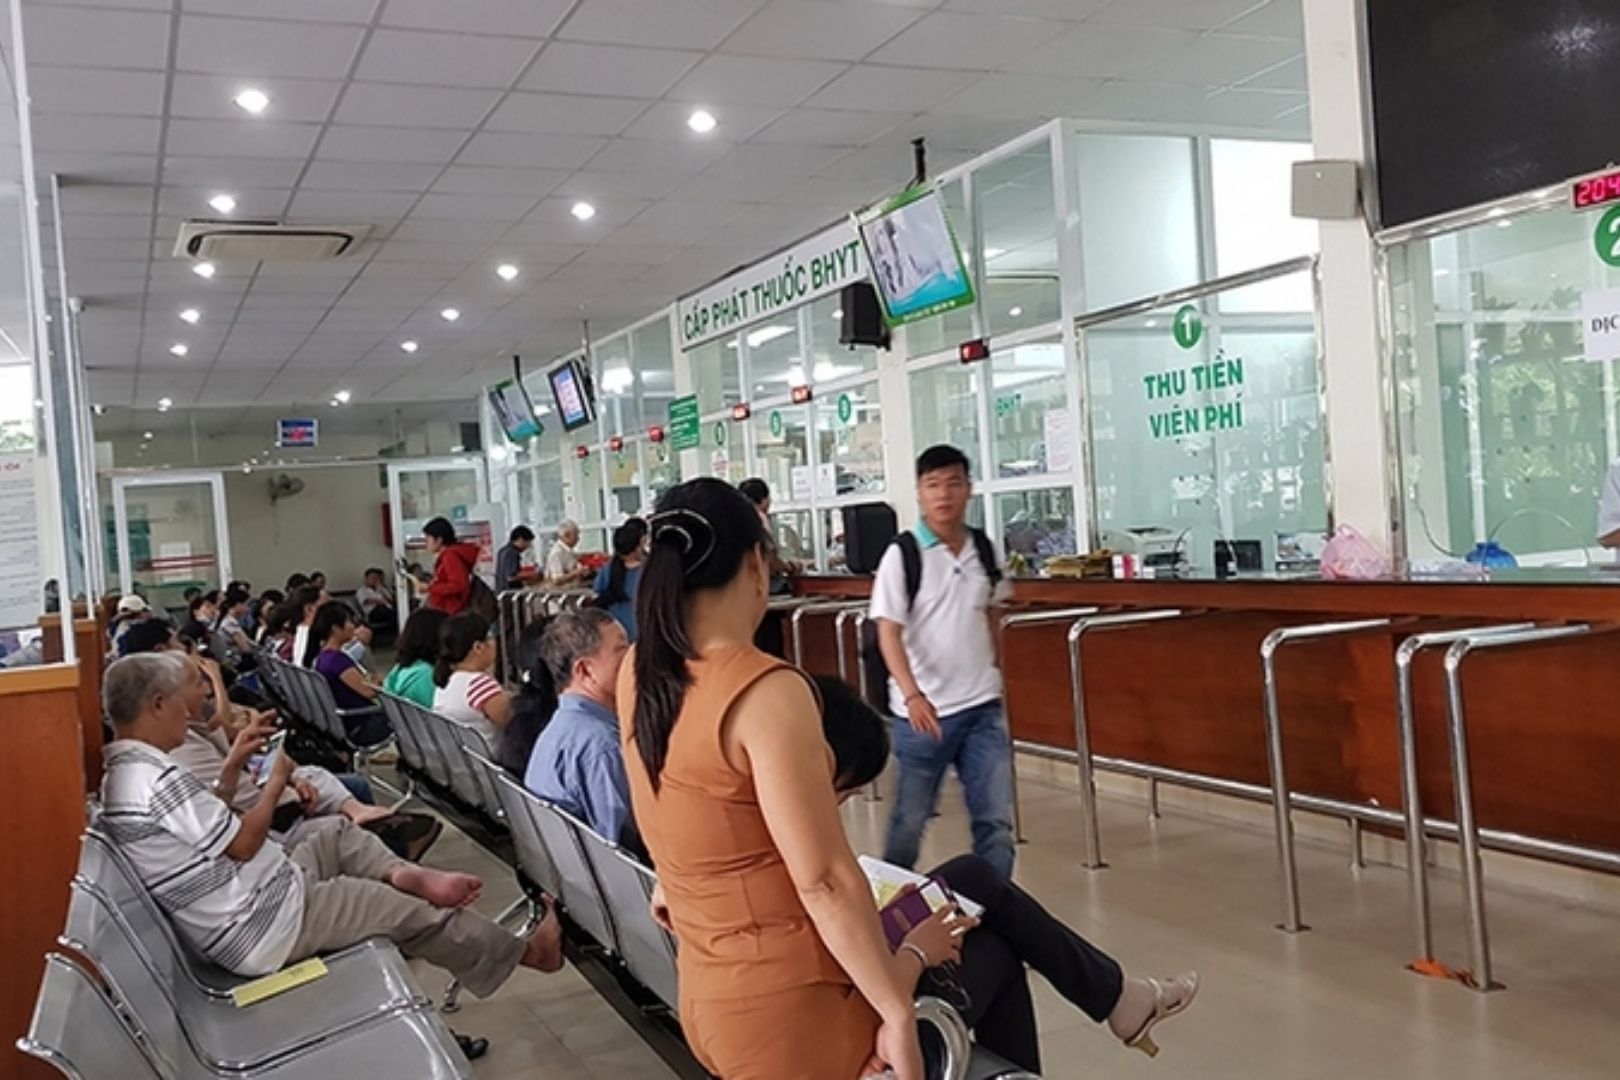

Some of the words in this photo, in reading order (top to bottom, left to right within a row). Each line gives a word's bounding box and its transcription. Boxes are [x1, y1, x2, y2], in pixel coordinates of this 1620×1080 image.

[712, 288, 748, 330] PHÁT
[752, 256, 807, 313] THUỐC
[811, 240, 859, 289] BHYT
[1181, 314, 1192, 341] 1
[1143, 370, 1187, 399] THU
[1191, 348, 1243, 392] TIỀN
[1149, 404, 1199, 444] VIỆN
[1204, 393, 1243, 431] PHÍ
